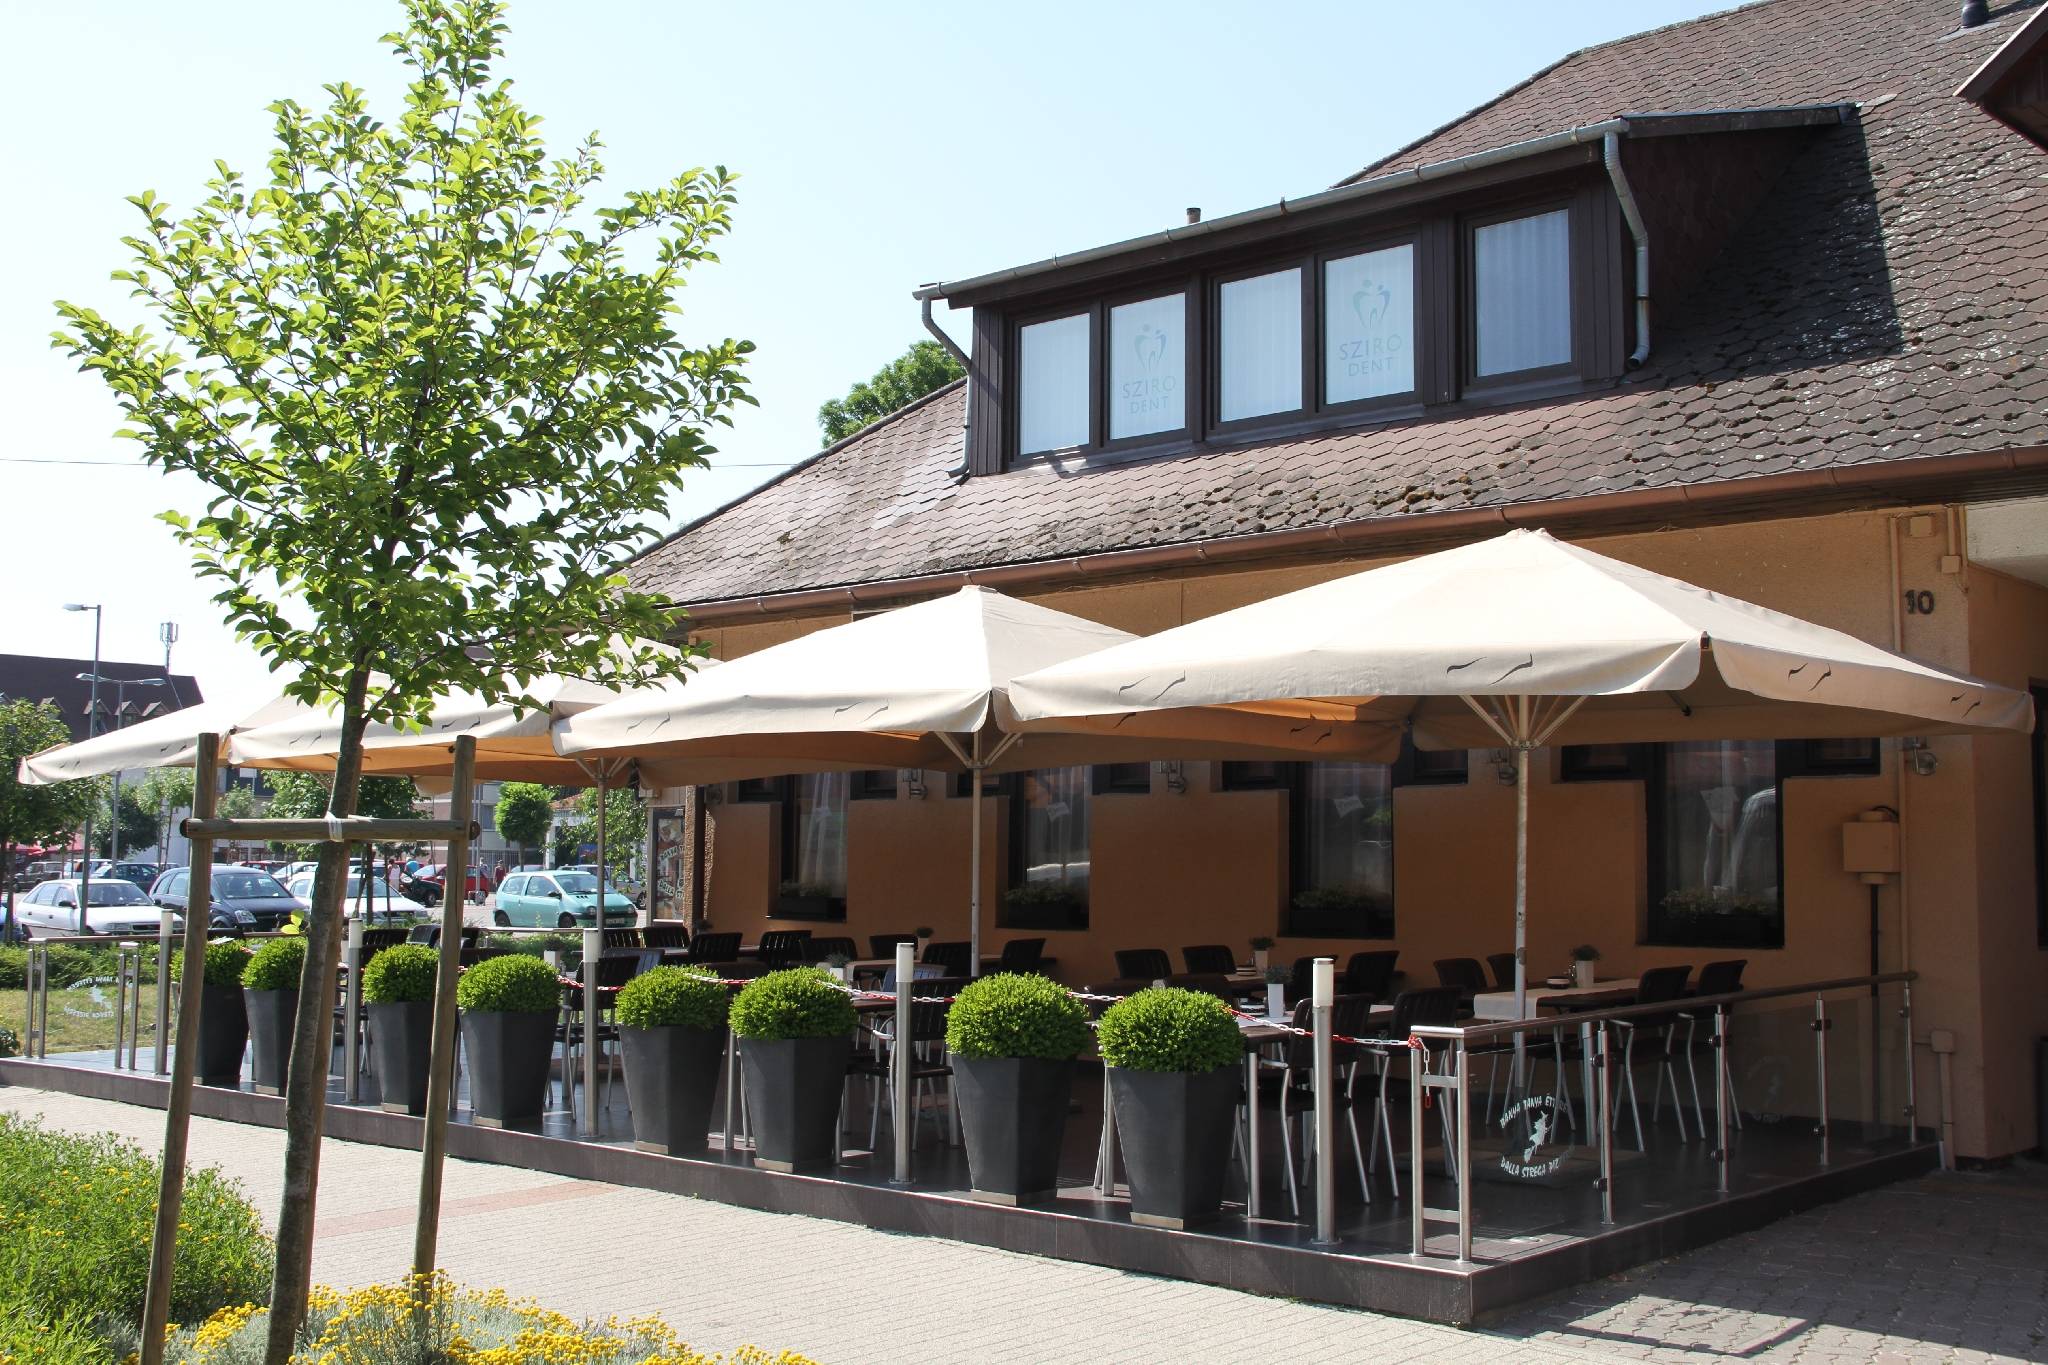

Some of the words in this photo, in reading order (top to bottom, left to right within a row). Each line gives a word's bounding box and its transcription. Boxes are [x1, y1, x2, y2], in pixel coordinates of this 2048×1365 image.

[1339, 333, 1402, 361] SZIRO
[1347, 356, 1394, 377] DENT
[1122, 375, 1176, 399] SZIRO
[1129, 395, 1169, 414] DENT
[1904, 589, 1935, 615] 10
[1500, 1155, 1520, 1176] DALLA
[1521, 1163, 1546, 1178] STREGA
